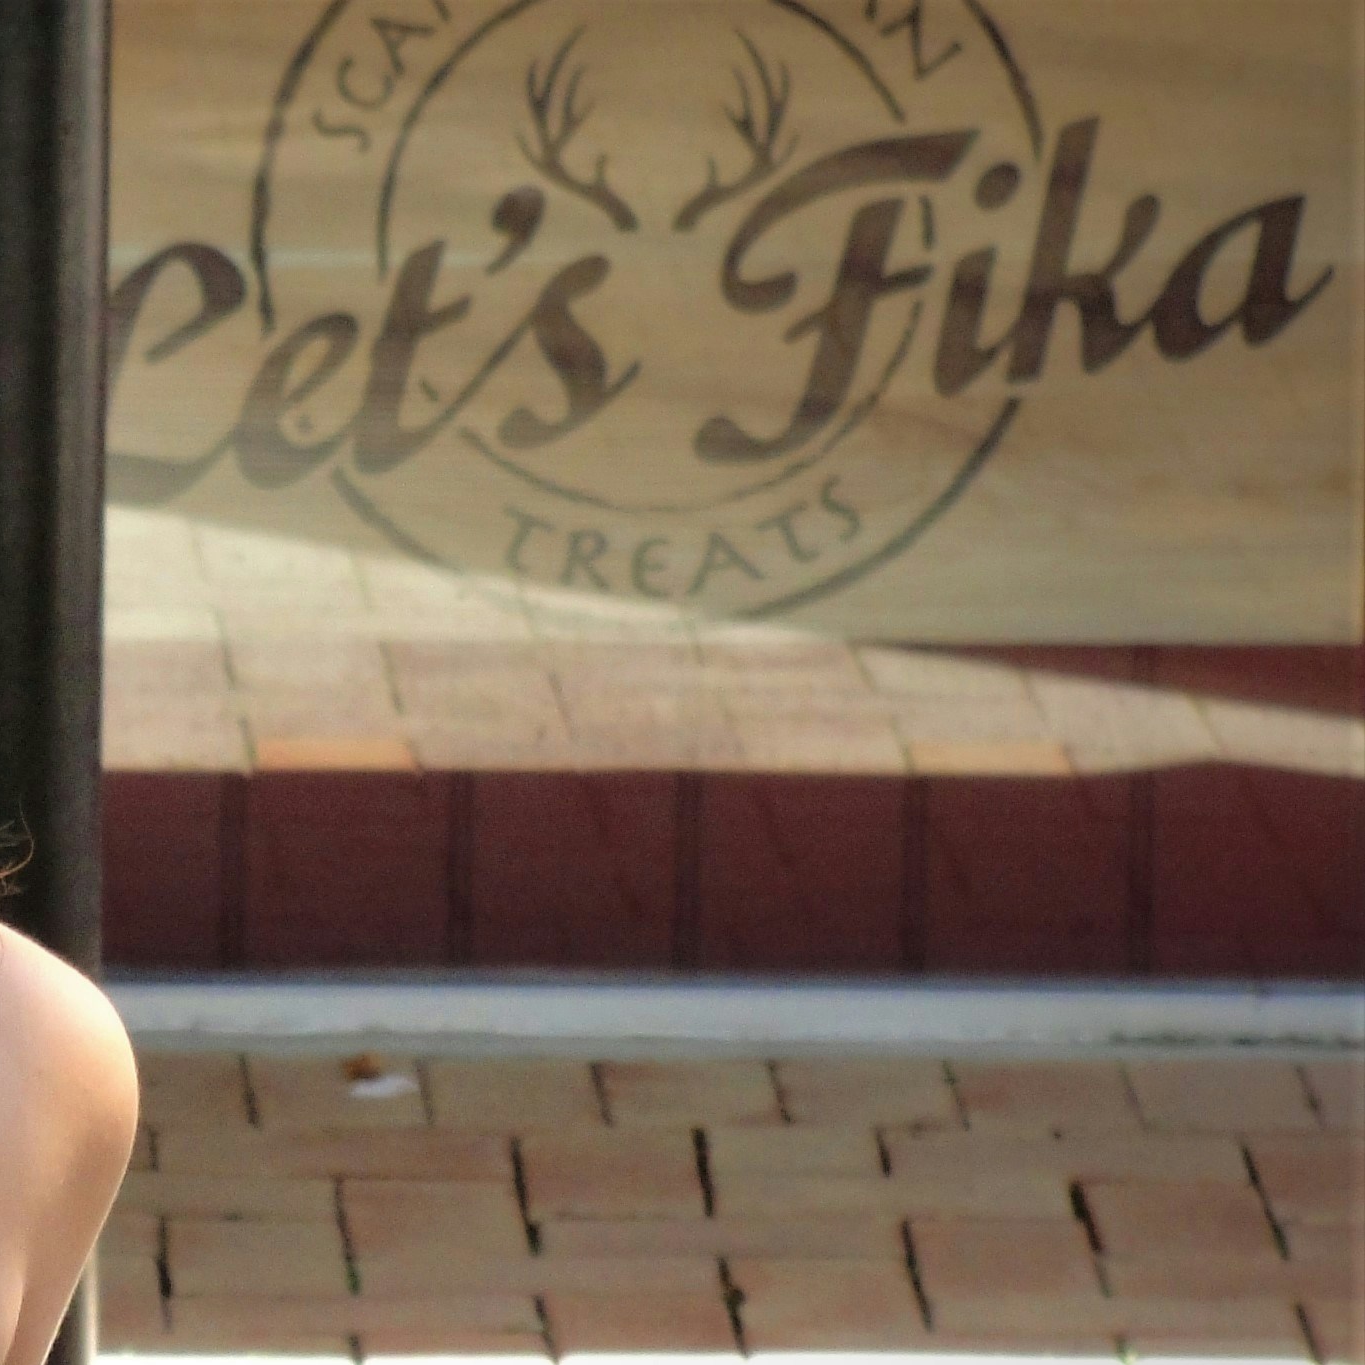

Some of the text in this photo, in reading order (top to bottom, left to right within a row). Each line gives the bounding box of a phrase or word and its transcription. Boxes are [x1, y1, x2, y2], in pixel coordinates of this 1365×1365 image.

[310, 0, 452, 153] SCA
[104, 115, 1334, 506] Let's Fika
[504, 473, 862, 600] TREATS
